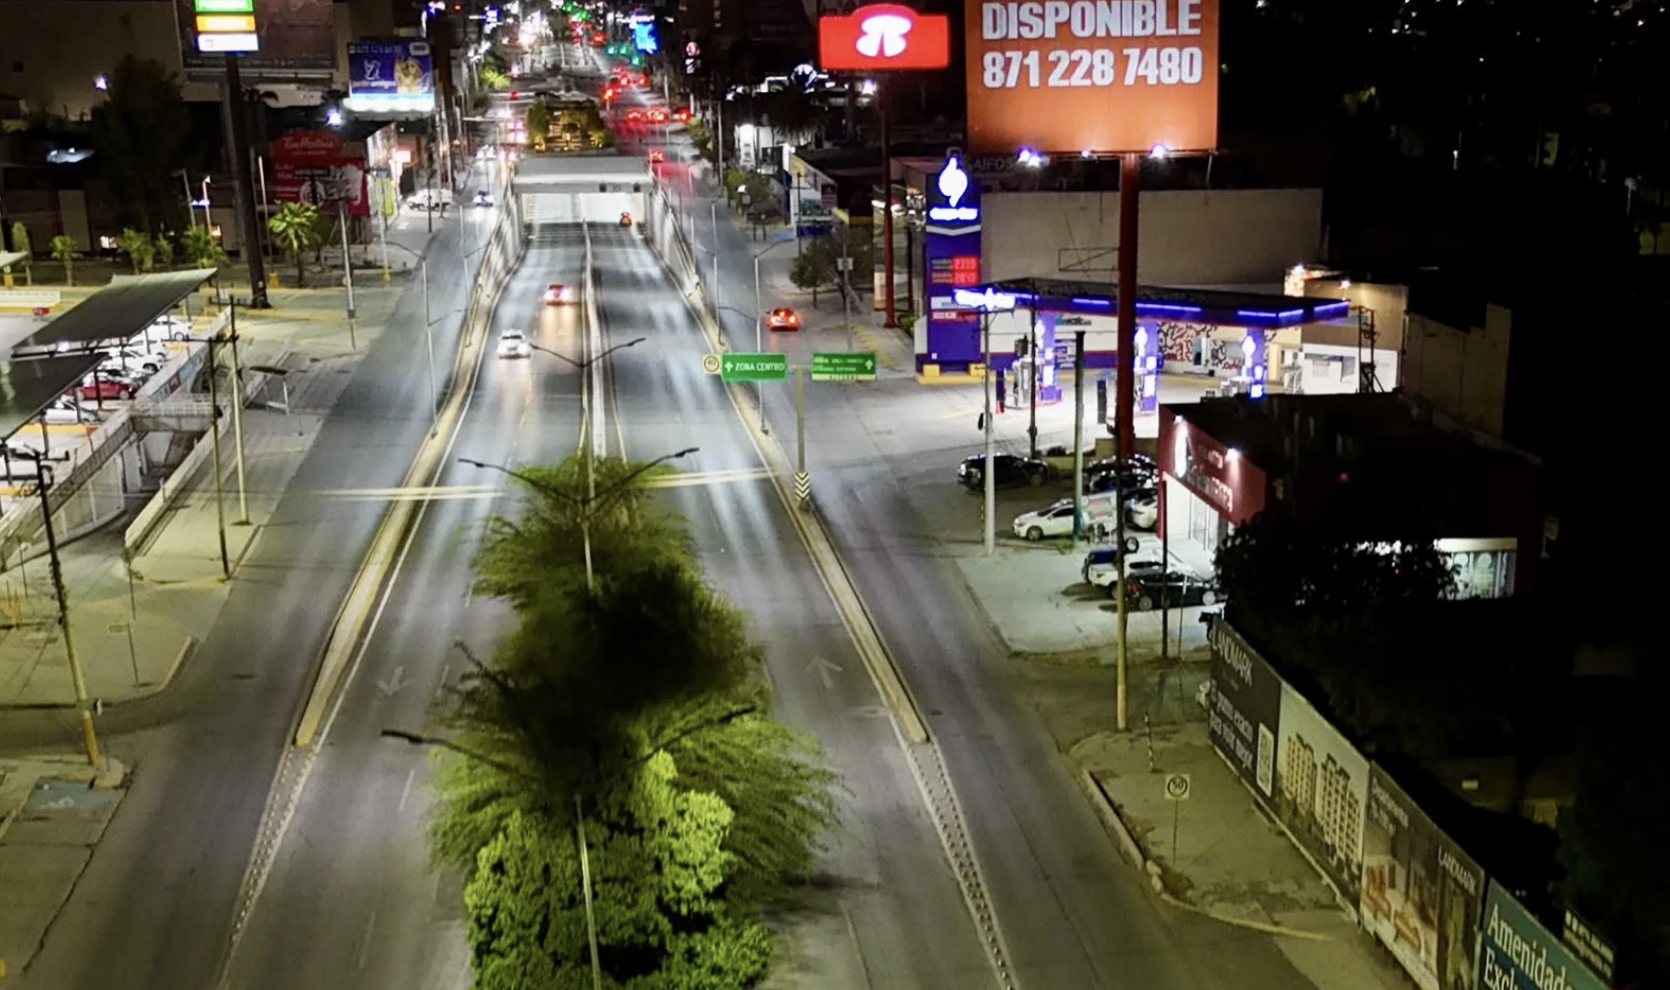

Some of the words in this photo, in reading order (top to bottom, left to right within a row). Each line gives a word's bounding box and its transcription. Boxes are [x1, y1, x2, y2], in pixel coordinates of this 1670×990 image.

[982, 0, 1201, 40] DISPONIBLE
[983, 50, 1040, 88] 871
[1048, 48, 1114, 87] 228
[1122, 46, 1203, 86] 7480
[735, 362, 755, 371] ZONA
[756, 362, 785, 371] CENTRO
[1487, 902, 1574, 990] Amenidad
